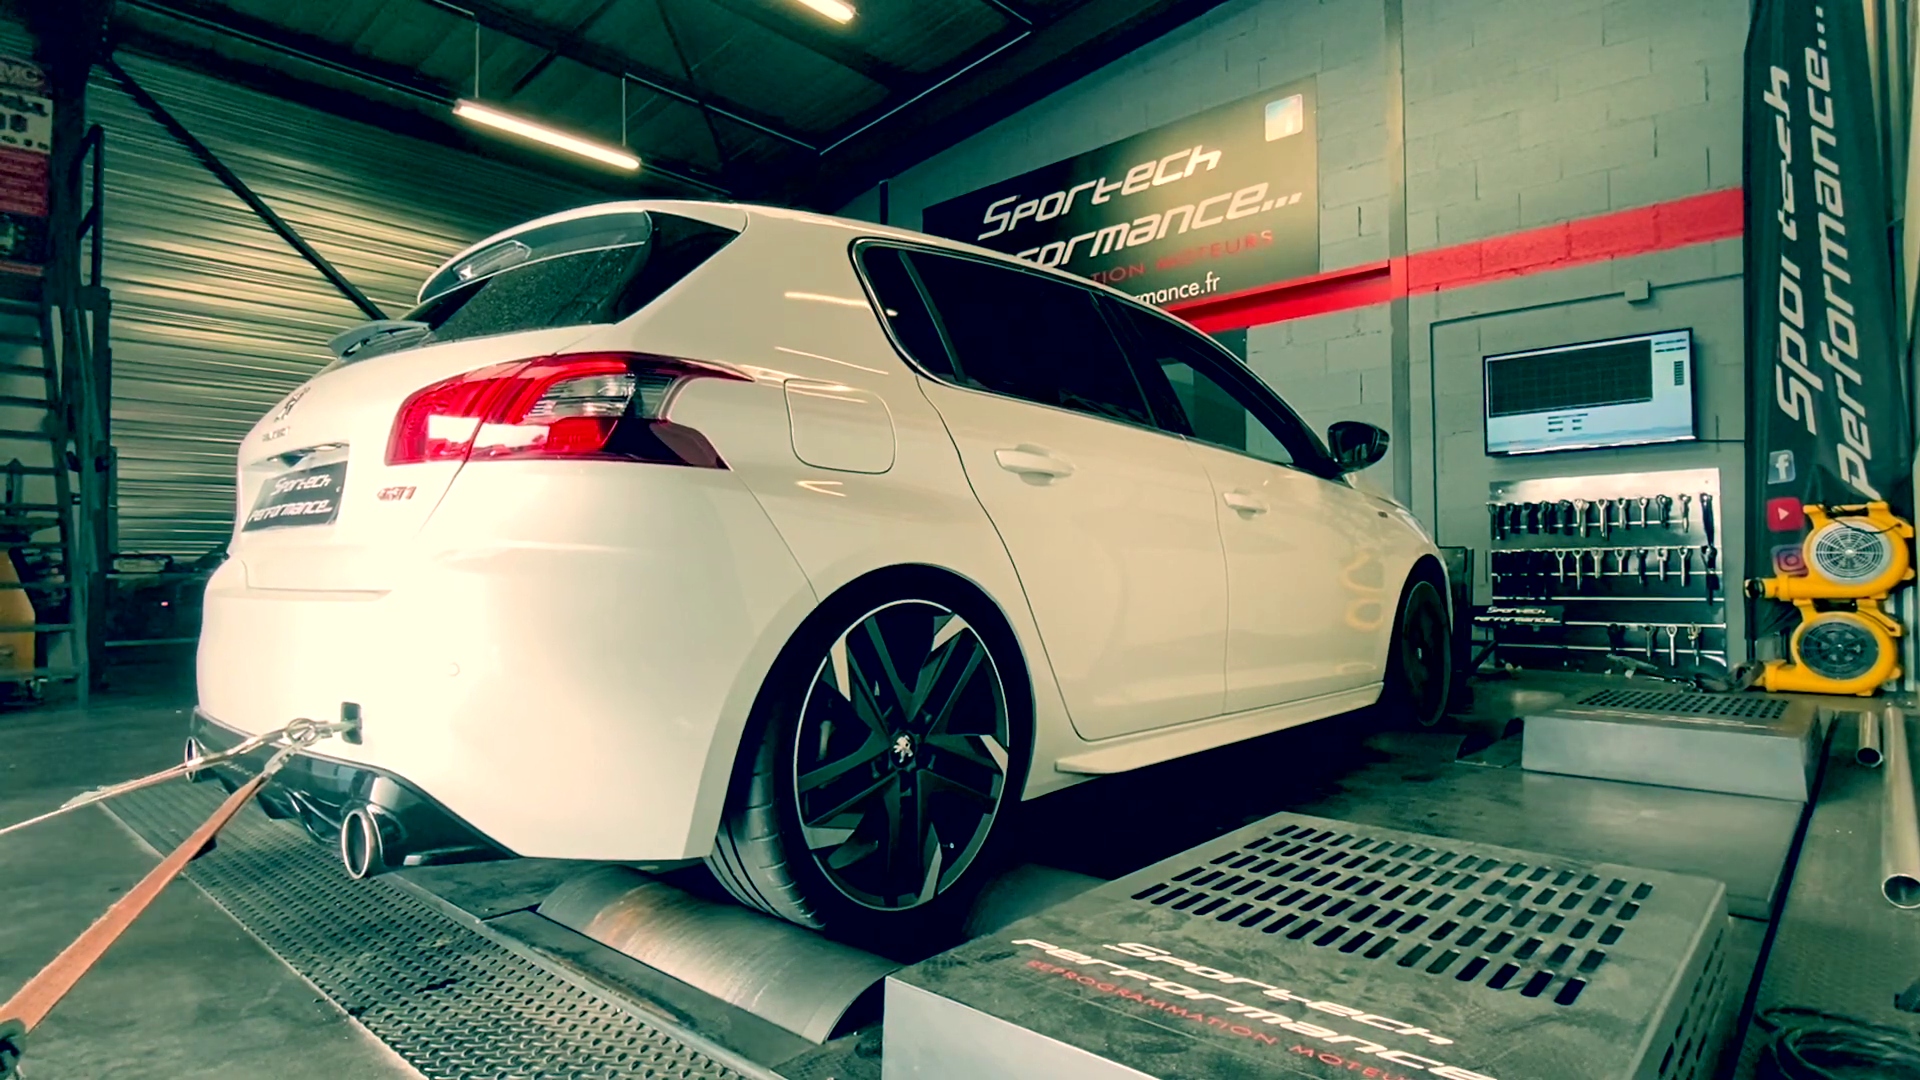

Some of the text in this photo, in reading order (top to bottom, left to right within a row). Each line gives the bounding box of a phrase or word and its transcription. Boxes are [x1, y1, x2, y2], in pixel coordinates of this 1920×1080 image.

[1016, 181, 1302, 268] ormance...
[1136, 271, 1221, 305] mance.fr
[1025, 959, 1279, 1046] REPROGRAMMATION
